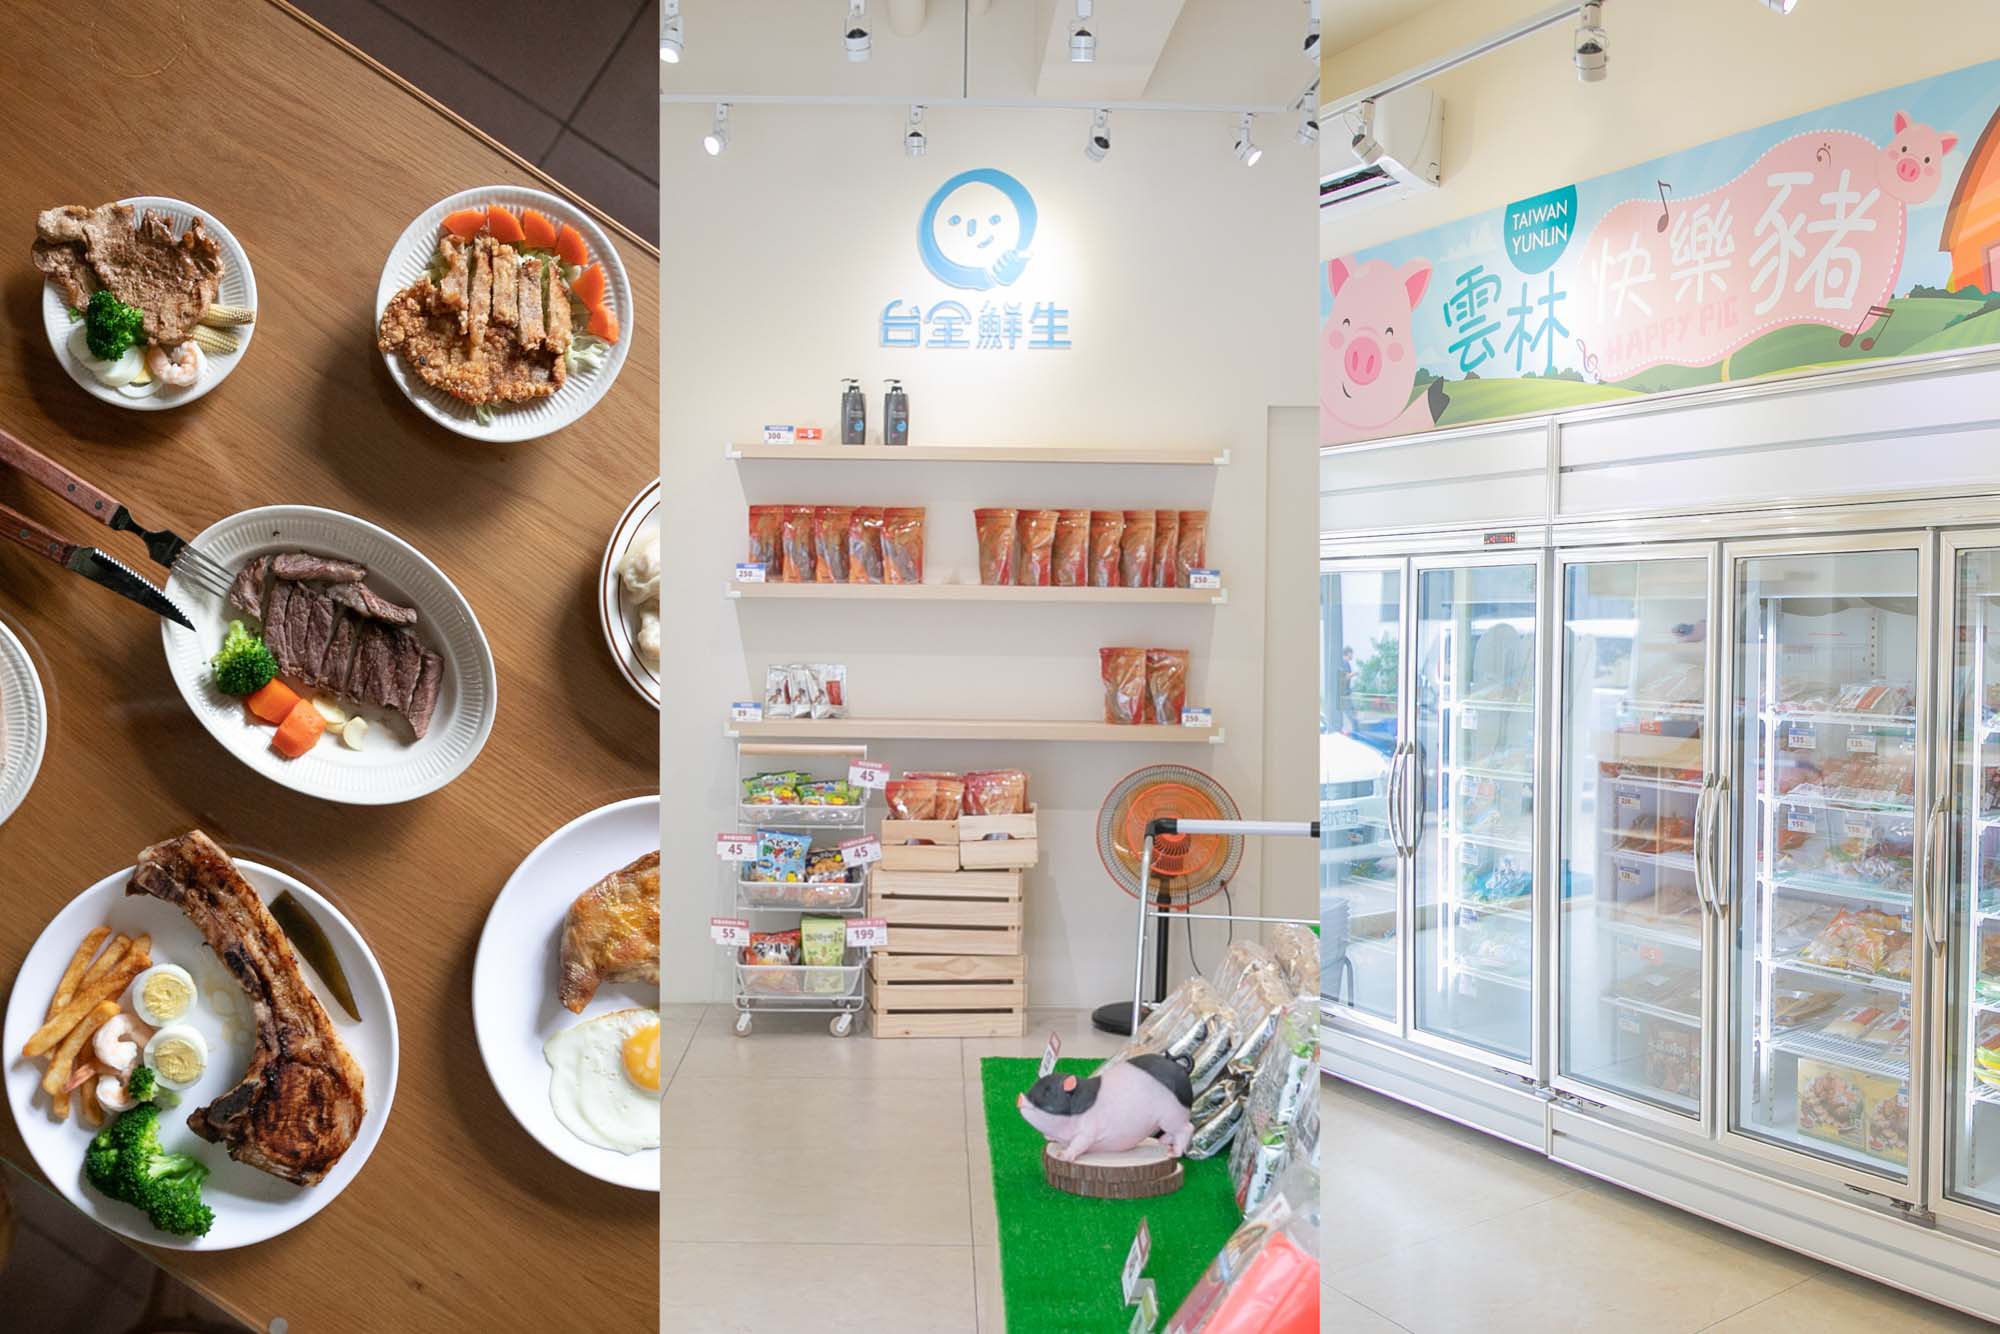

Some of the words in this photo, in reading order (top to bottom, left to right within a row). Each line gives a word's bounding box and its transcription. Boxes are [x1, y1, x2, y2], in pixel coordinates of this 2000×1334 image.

[1512, 199, 1568, 231] TAIWAN
[1512, 221, 1568, 256] YUNLIN
[1443, 264, 1570, 373] 雲林
[1591, 168, 1881, 318] 快樂豬
[880, 299, 1072, 350] 台全鮮生
[1607, 310, 1690, 366] HAPPY
[1699, 296, 1740, 337] PIG
[859, 770, 875, 782] 45
[728, 843, 743, 856] 45
[854, 845, 869, 858] 45
[722, 927, 736, 939] 55
[854, 928, 875, 940] 199
